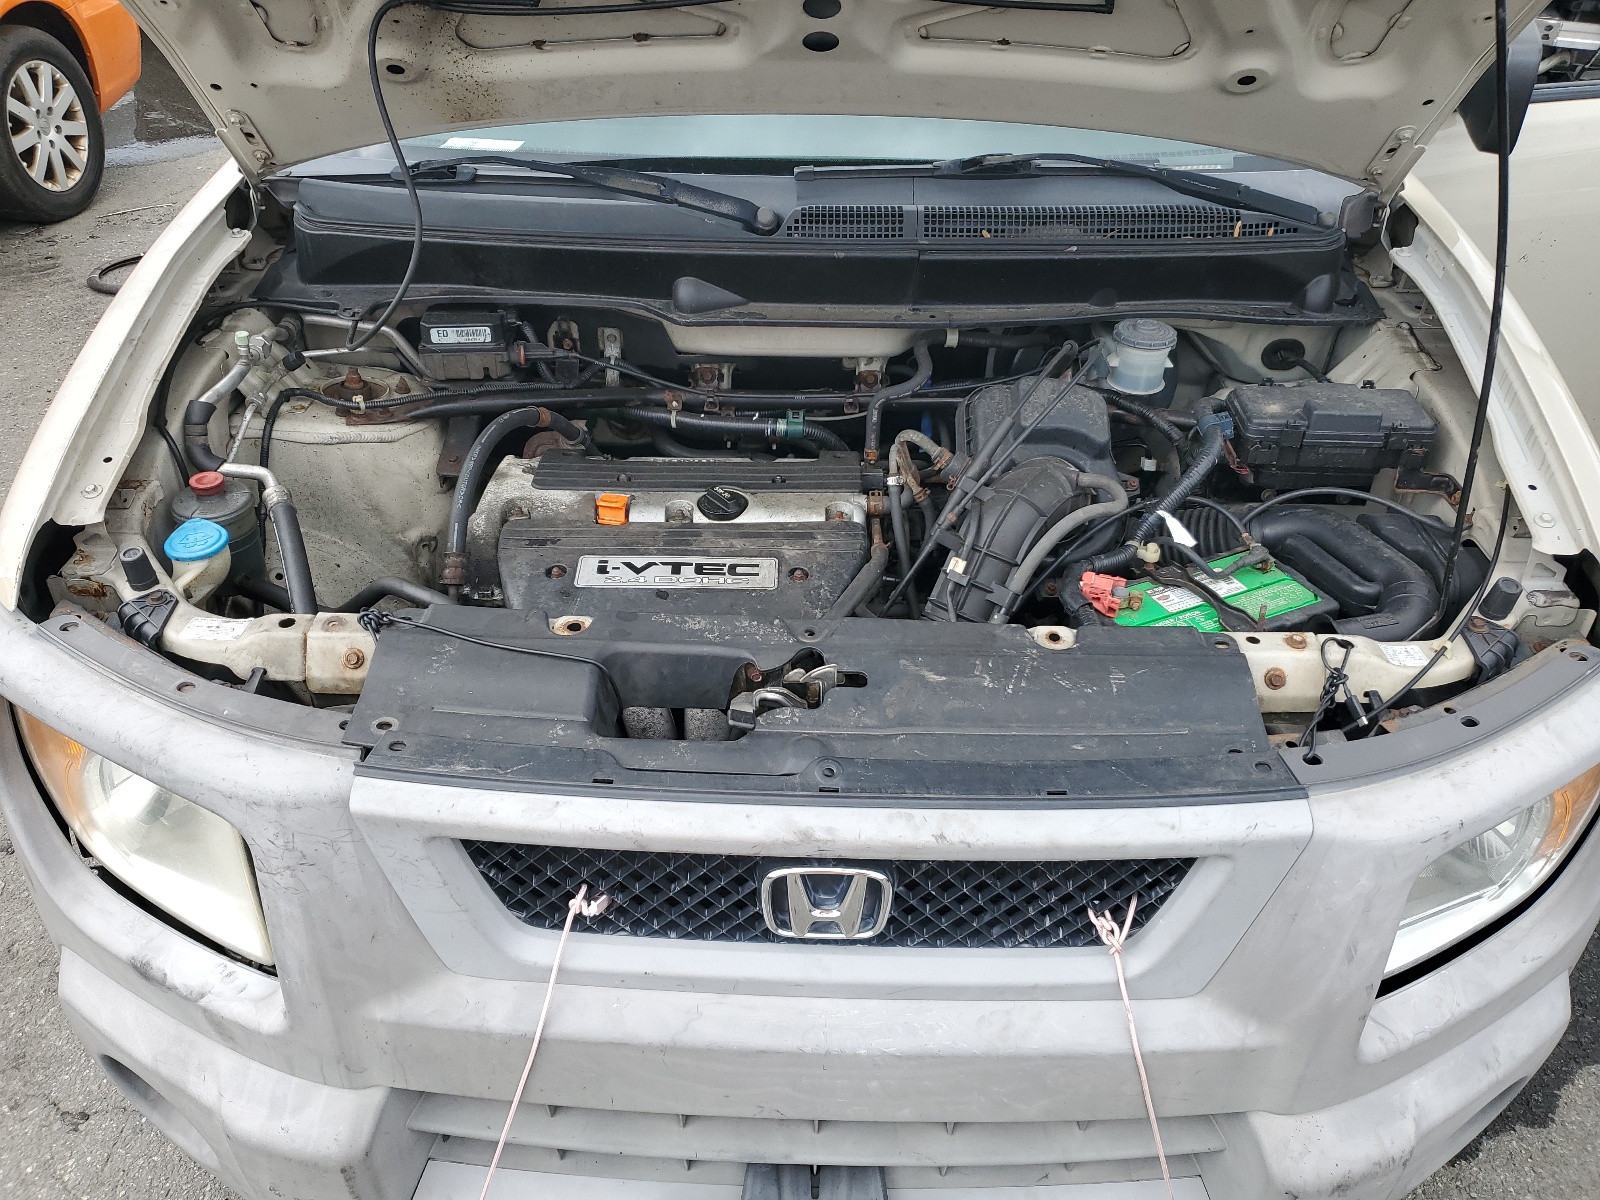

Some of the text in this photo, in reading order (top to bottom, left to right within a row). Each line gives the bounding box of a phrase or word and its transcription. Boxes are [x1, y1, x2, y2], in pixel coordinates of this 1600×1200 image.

[436, 329, 449, 338] ED
[597, 559, 760, 577] i-VTEC
[653, 576, 750, 585] DOHC
